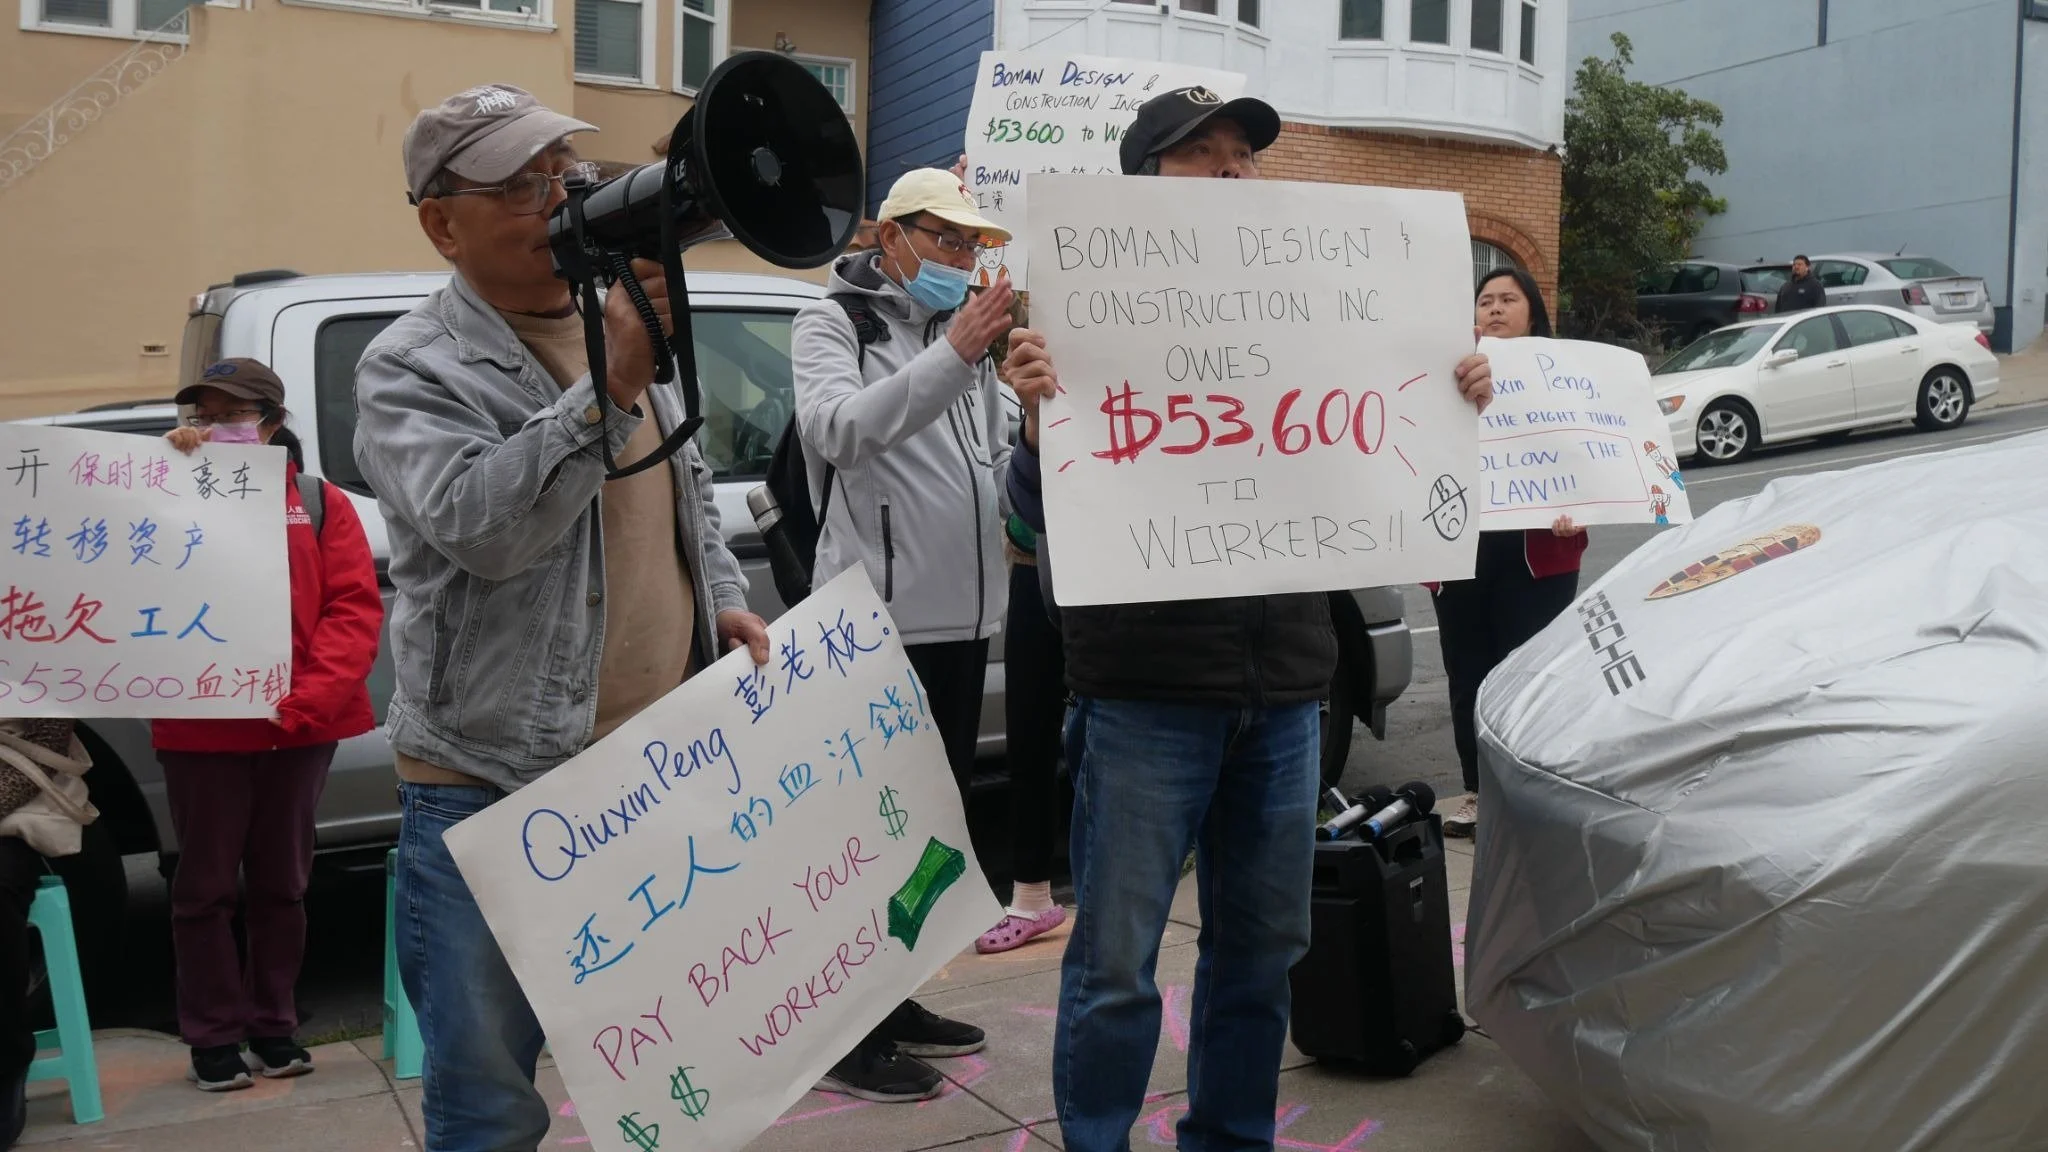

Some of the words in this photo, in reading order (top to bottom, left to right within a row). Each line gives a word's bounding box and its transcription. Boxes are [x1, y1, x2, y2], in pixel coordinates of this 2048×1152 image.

[992, 62, 1044, 88] BOMAN
[1060, 60, 1134, 87] DESIGN
[1005, 91, 1100, 112] CONSTRUCTION
[983, 116, 1065, 145] $53600
[1081, 125, 1095, 143] to
[975, 166, 1021, 186] BOMAN
[1053, 225, 1201, 270] BOMAN
[1236, 225, 1372, 268] DESIGN
[1065, 287, 1311, 329] CONSTRUCTION
[1337, 288, 1385, 323] INC.
[1165, 343, 1271, 383] OWES
[1091, 379, 1385, 464] $53,600
[1481, 413, 1519, 429] THE
[1525, 410, 1577, 425] RIGHT
[1479, 450, 1559, 472] OLLOW
[1579, 440, 1623, 460] THE
[1197, 477, 1259, 505] TO
[1489, 473, 1577, 505] LAW!!!
[11, 514, 207, 570] 转移资产
[1128, 510, 1404, 570] WORKERS!!
[1577, 590, 1647, 696] ORSCHE
[593, 995, 673, 1081] PAY
[688, 906, 793, 1008] BACK
[793, 836, 880, 912] YOUR
[739, 908, 888, 1057] WORKERS!
